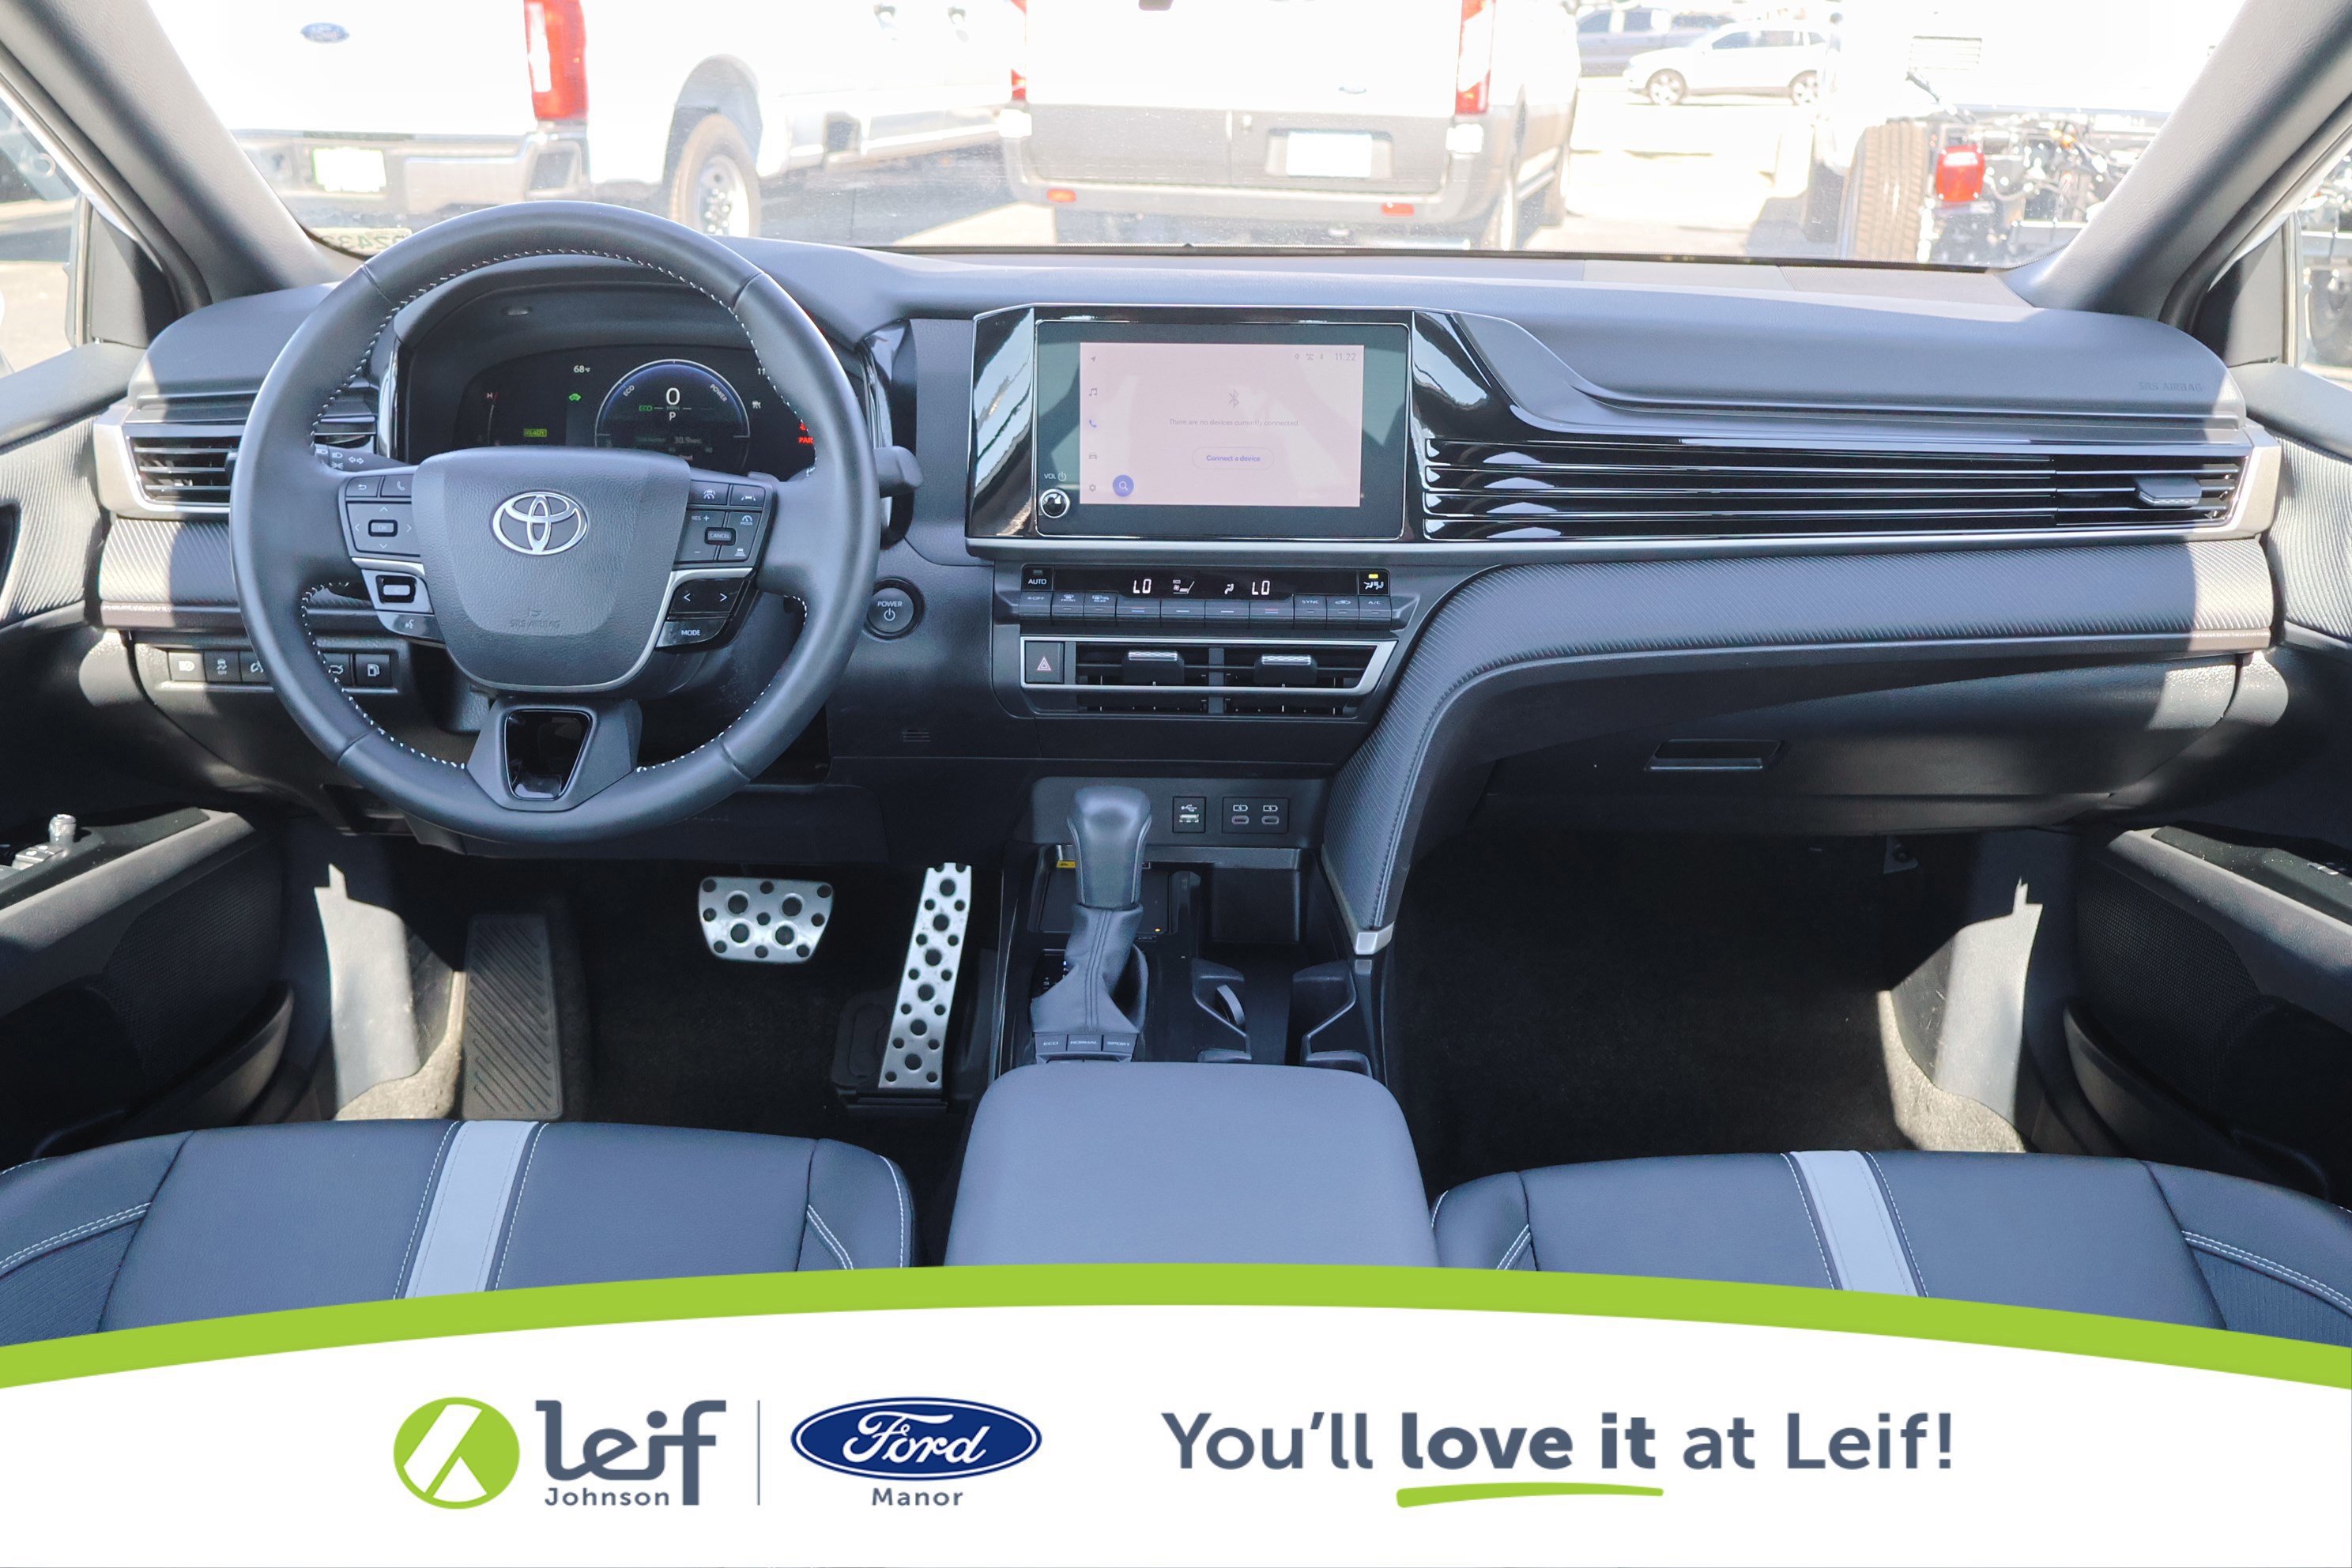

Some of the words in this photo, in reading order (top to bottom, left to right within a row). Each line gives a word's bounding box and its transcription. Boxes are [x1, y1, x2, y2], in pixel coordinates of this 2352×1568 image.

[623, 385, 635, 396] ECO
[665, 387, 680, 405] 0
[710, 383, 727, 401] POWER
[669, 411, 677, 420] P
[1133, 579, 1152, 594] LO
[1251, 580, 1271, 595] LO
